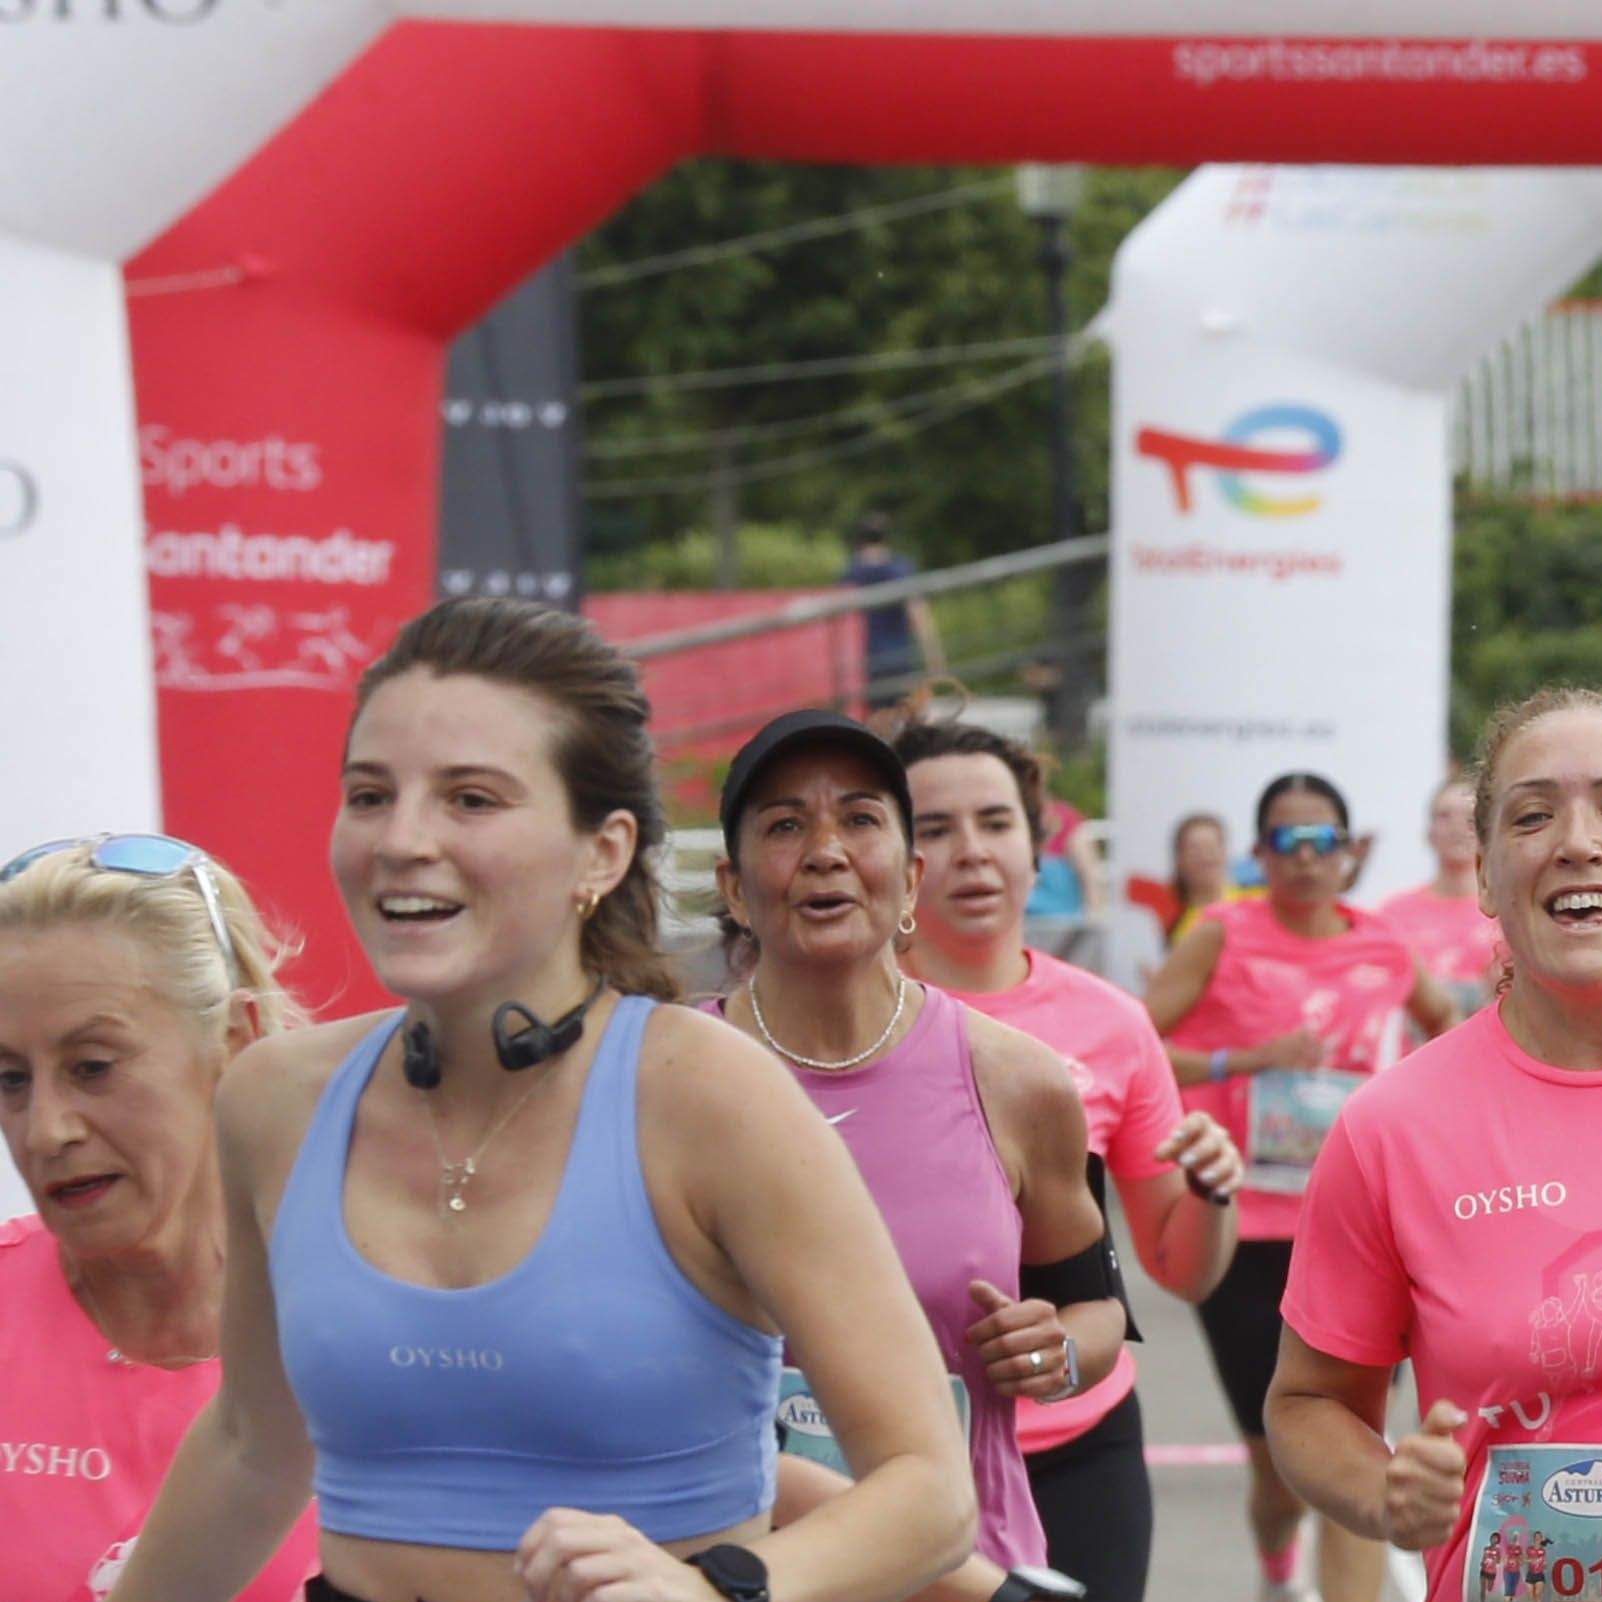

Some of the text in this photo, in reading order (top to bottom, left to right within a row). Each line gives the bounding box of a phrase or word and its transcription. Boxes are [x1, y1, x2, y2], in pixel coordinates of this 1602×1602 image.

[138, 424, 323, 496] Sports
[144, 522, 395, 587] antander
[1453, 1180, 1568, 1221] OYSHO
[389, 1343, 504, 1372] OYSHO
[0, 1441, 112, 1482] YSHO
